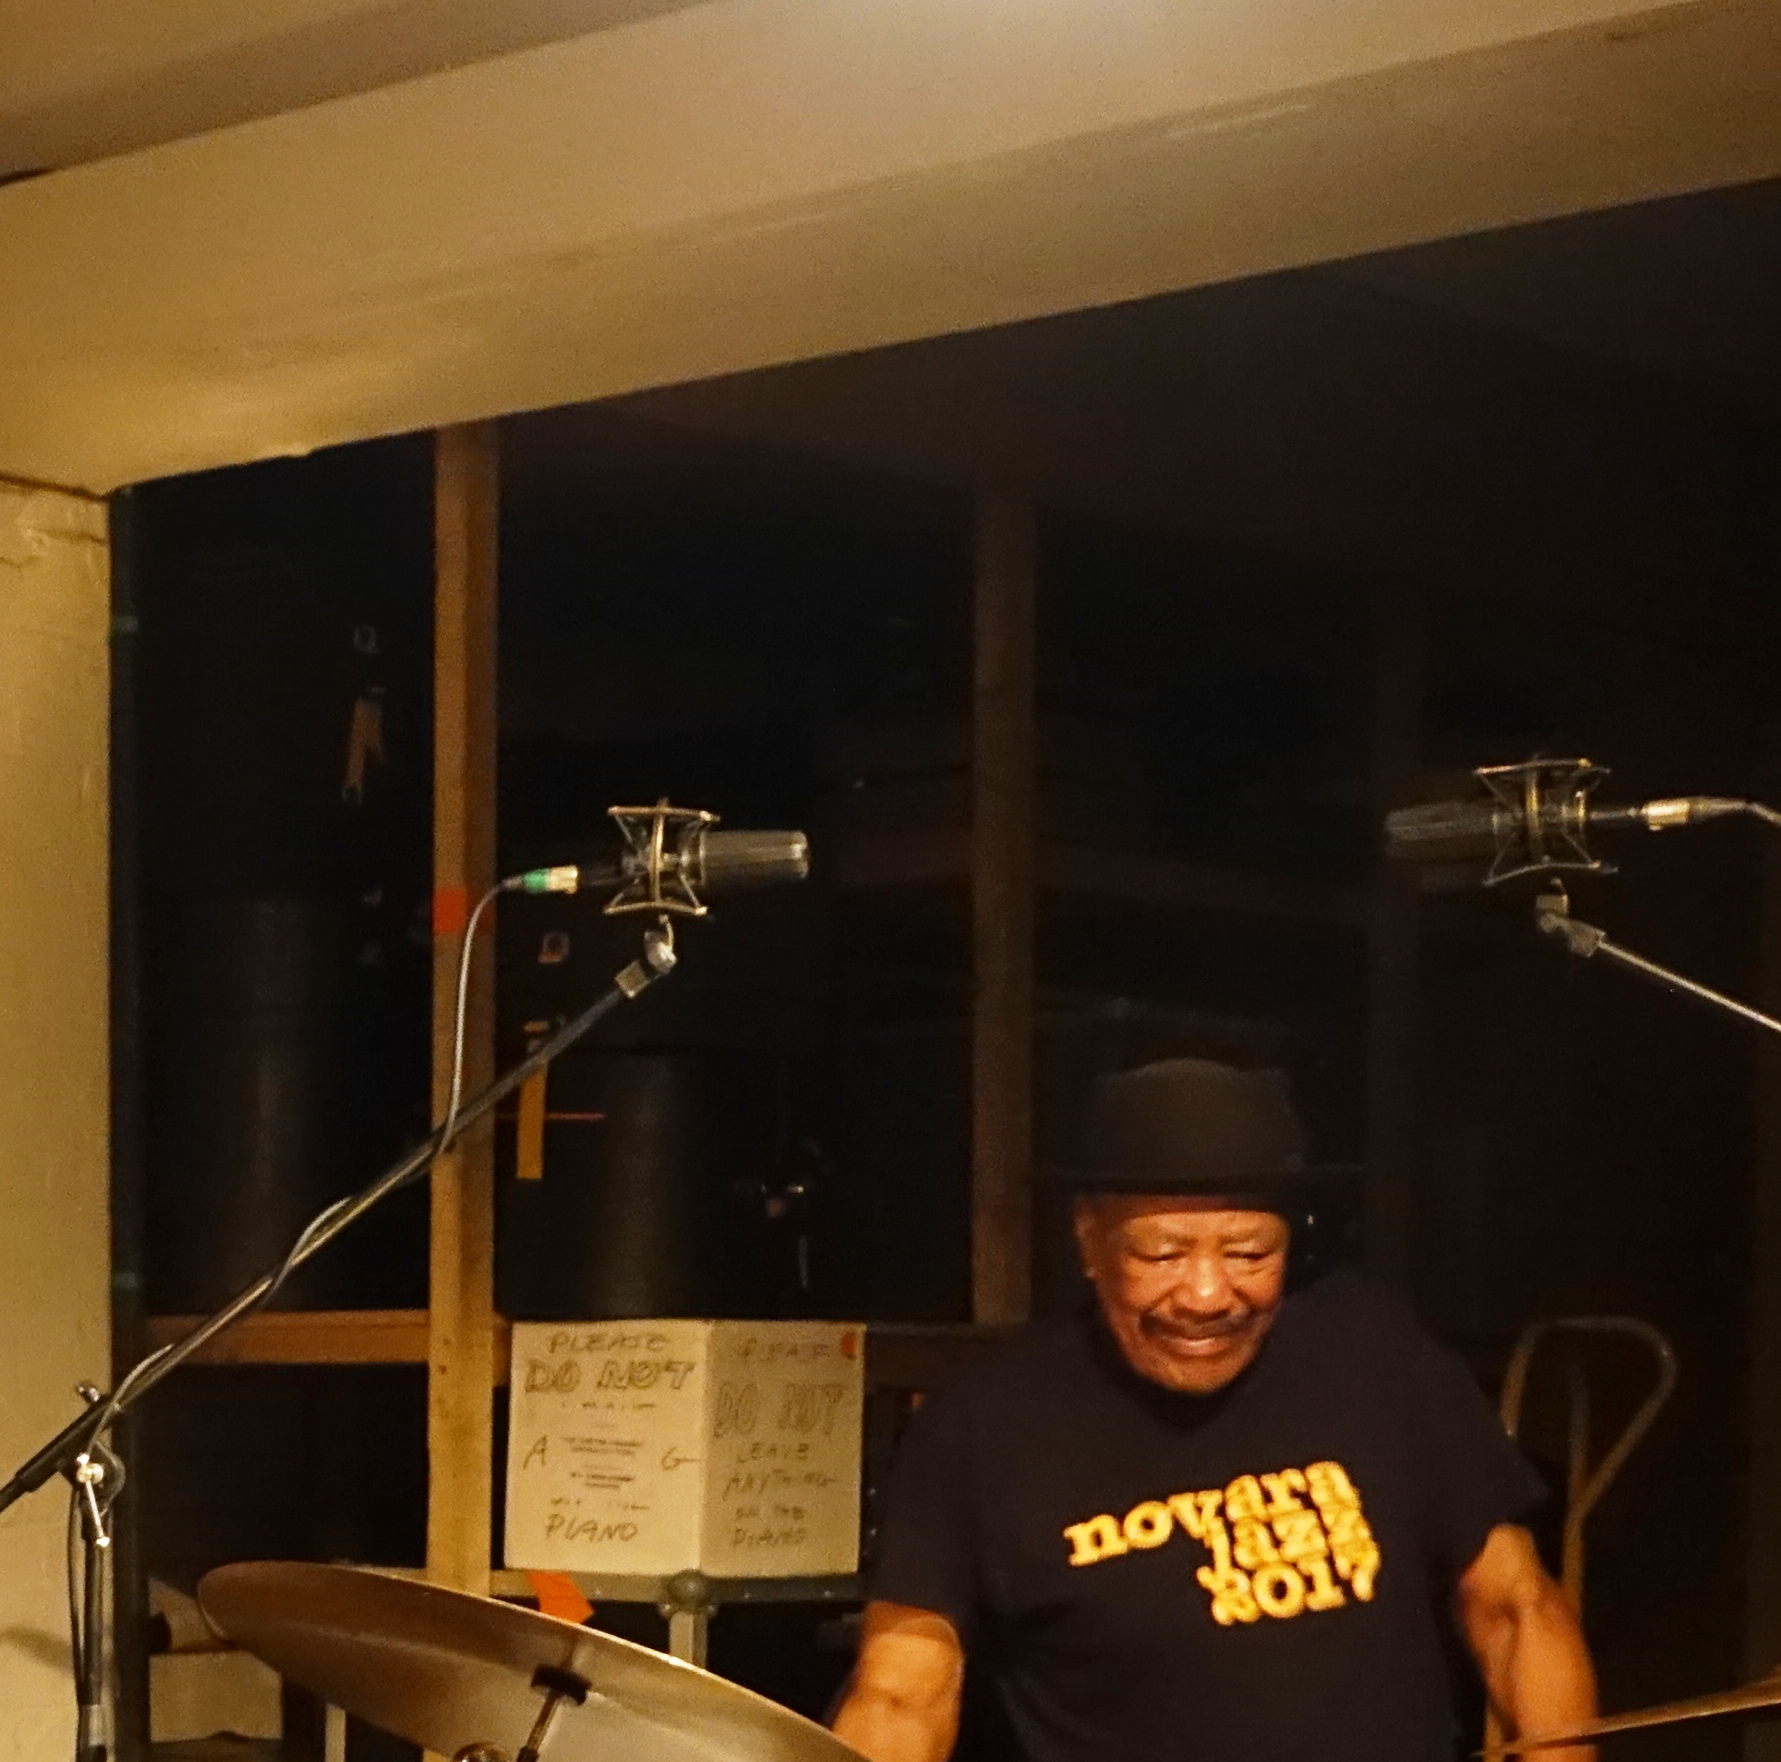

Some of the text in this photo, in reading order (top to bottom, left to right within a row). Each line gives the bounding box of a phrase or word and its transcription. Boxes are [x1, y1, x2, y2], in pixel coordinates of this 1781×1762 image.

[525, 1359, 697, 1395] DO NOT
[546, 1512, 639, 1543] PIANO
[1063, 1461, 1362, 1567] novara
